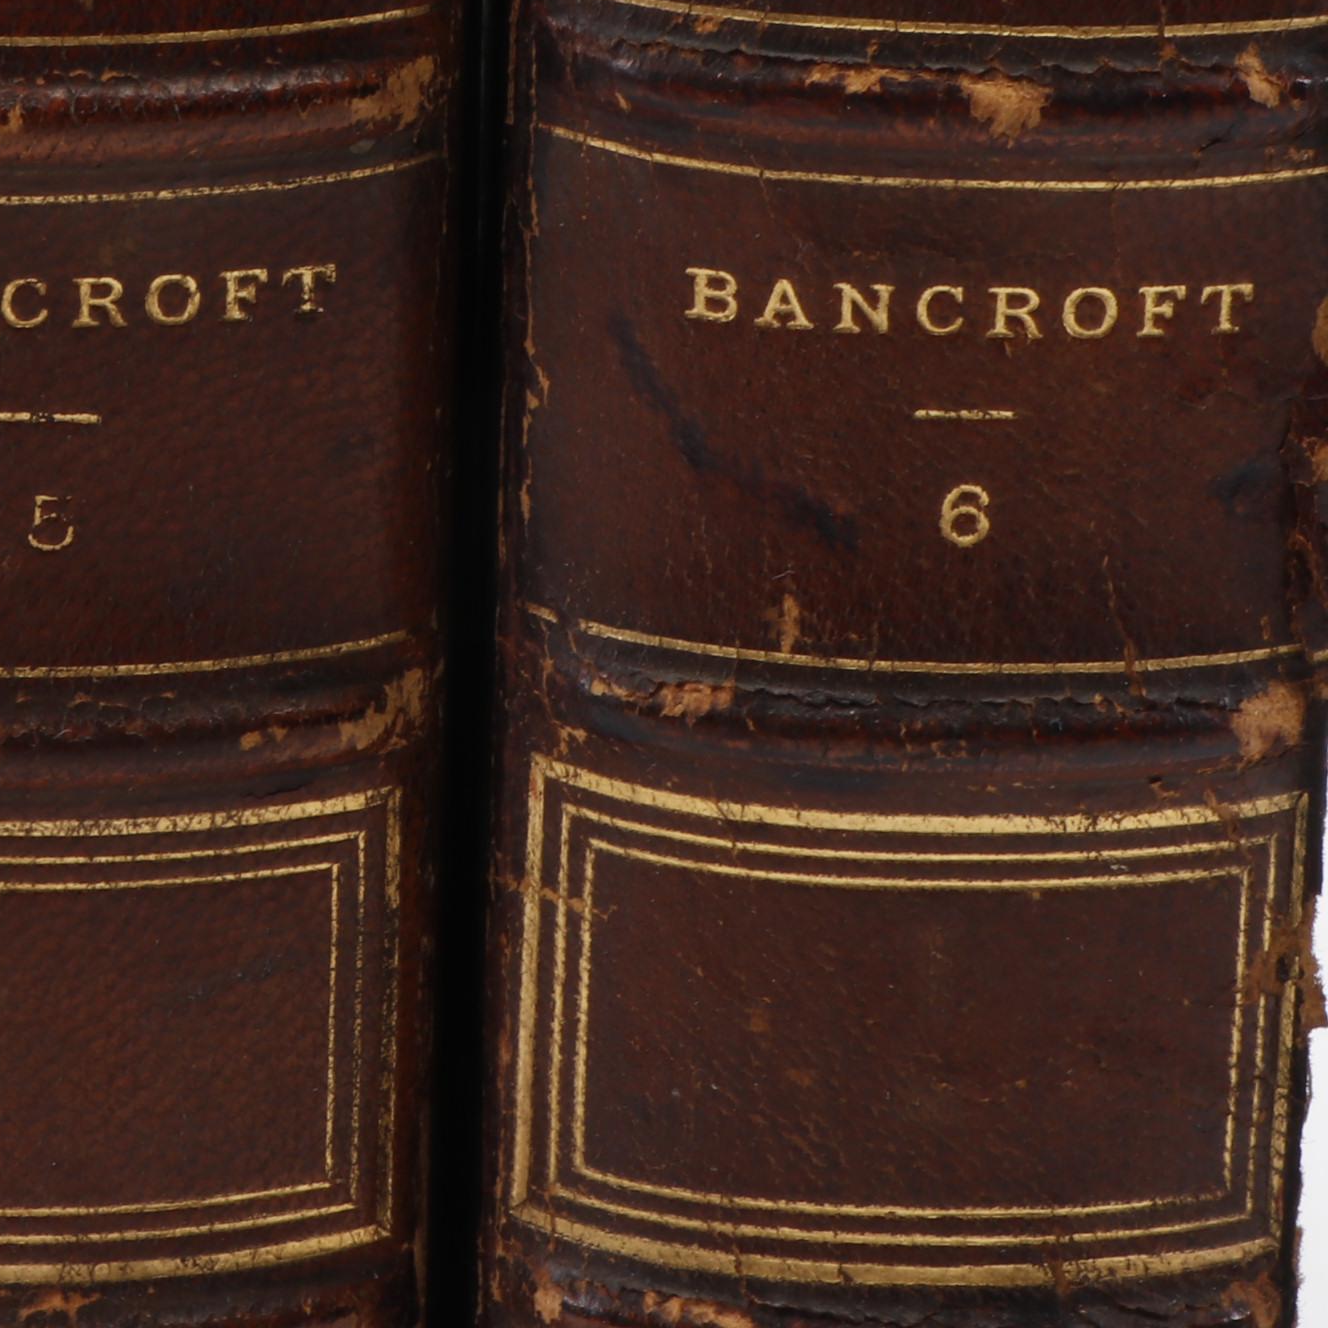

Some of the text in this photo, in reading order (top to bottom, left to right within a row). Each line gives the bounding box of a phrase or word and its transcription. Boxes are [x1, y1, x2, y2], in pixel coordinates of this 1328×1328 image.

[683, 266, 1255, 340] BANCROFT
[26, 494, 77, 552] 5
[939, 483, 991, 548] 6
